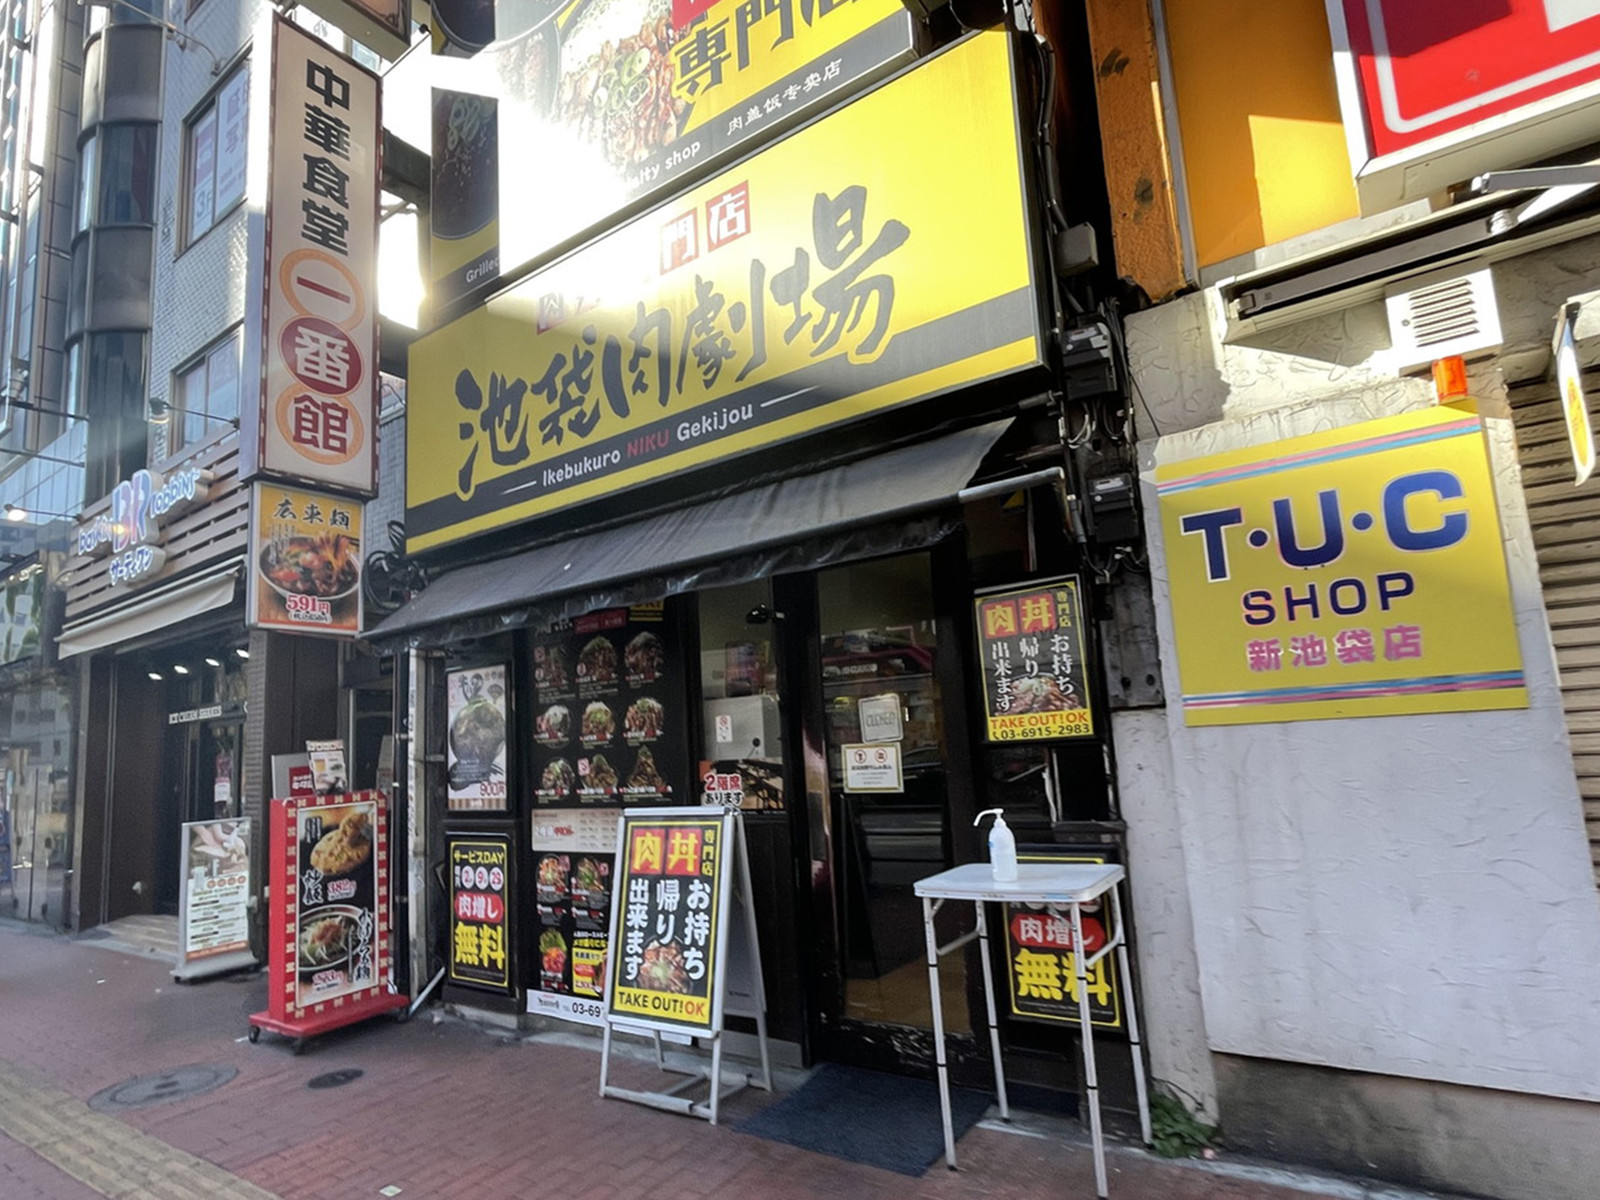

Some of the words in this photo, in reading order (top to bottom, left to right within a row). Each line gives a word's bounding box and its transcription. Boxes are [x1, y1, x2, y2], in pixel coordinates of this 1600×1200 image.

[674, 0, 858, 96] 専門
[726, 57, 842, 136] 肉盖饭专卖店
[302, 59, 350, 256] 中華食堂
[665, 141, 701, 169] shop
[293, 275, 350, 455] 一番館
[455, 185, 910, 498] 池袋肉劇場
[542, 447, 621, 487] Ikebukuro
[626, 430, 669, 459] NIKU
[677, 403, 753, 442] Gekijou
[286, 594, 329, 613] 591円
[986, 598, 1051, 636] 肉丼
[1242, 571, 1416, 625] SHOP
[1019, 637, 1040, 678] 帰り
[1051, 634, 1074, 695] お持ち
[1246, 624, 1423, 672] 新池袋店
[992, 641, 1015, 711] 出来ます
[990, 716, 1025, 730] TAKE
[1001, 723, 1090, 740] 03-6915-2983
[705, 792, 743, 805] あります
[454, 850, 504, 865] サービスDAY
[633, 831, 698, 872] 肉丼
[701, 829, 716, 877] 専門店
[458, 894, 498, 919] 肉増し
[625, 878, 649, 981] 出来ます
[656, 879, 681, 945] 帰り
[684, 879, 711, 980] お持ち
[455, 921, 505, 970] 無料
[1015, 948, 1112, 1006] 無料
[618, 991, 649, 1008] TAKE
[685, 999, 706, 1018] OK
